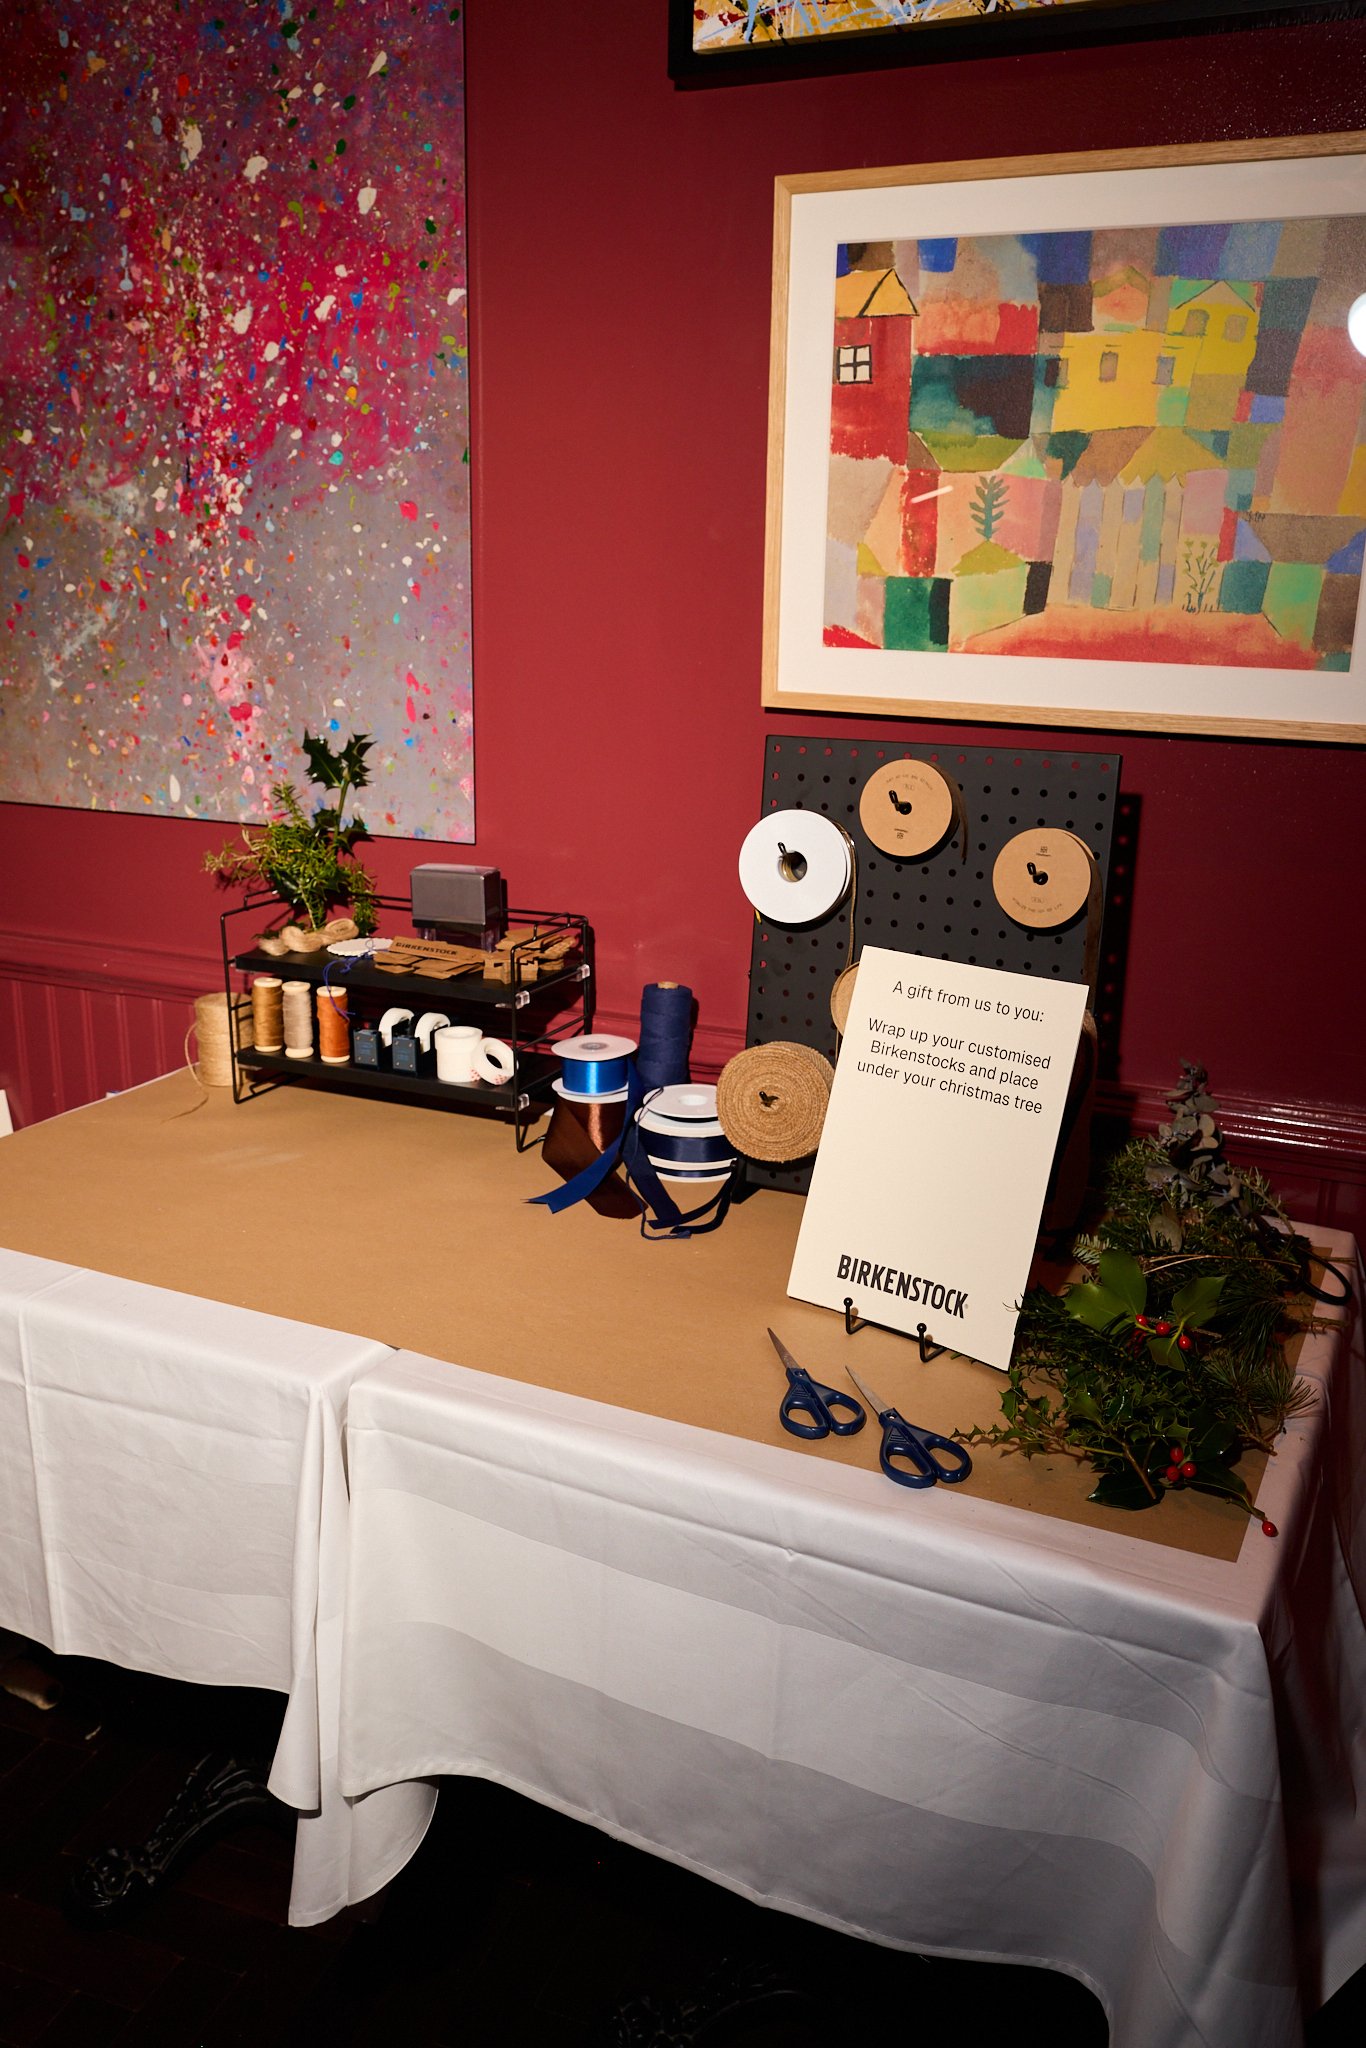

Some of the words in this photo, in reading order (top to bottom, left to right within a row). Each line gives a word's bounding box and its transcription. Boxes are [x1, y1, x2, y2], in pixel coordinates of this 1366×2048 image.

[395, 942, 458, 956] BIRKENSTOCK
[893, 981, 903, 995] A
[908, 985, 933, 1000] gift
[937, 989, 970, 1008] from
[974, 999, 992, 1012] us
[996, 1001, 1010, 1016] to
[1013, 1006, 1044, 1022] you:
[868, 1018, 906, 1038] Wrap
[909, 1029, 928, 1044] up
[932, 1034, 965, 1050] your
[968, 1042, 1051, 1069] customised
[870, 1039, 966, 1073] Birkenstocks
[969, 1062, 997, 1080] and
[999, 1070, 1039, 1091] place
[857, 1059, 900, 1079] under
[903, 1070, 936, 1088] your
[939, 1076, 1010, 1106] christmas
[1014, 1094, 1042, 1113] tree
[837, 1254, 968, 1319] BIRKENSTOCK
